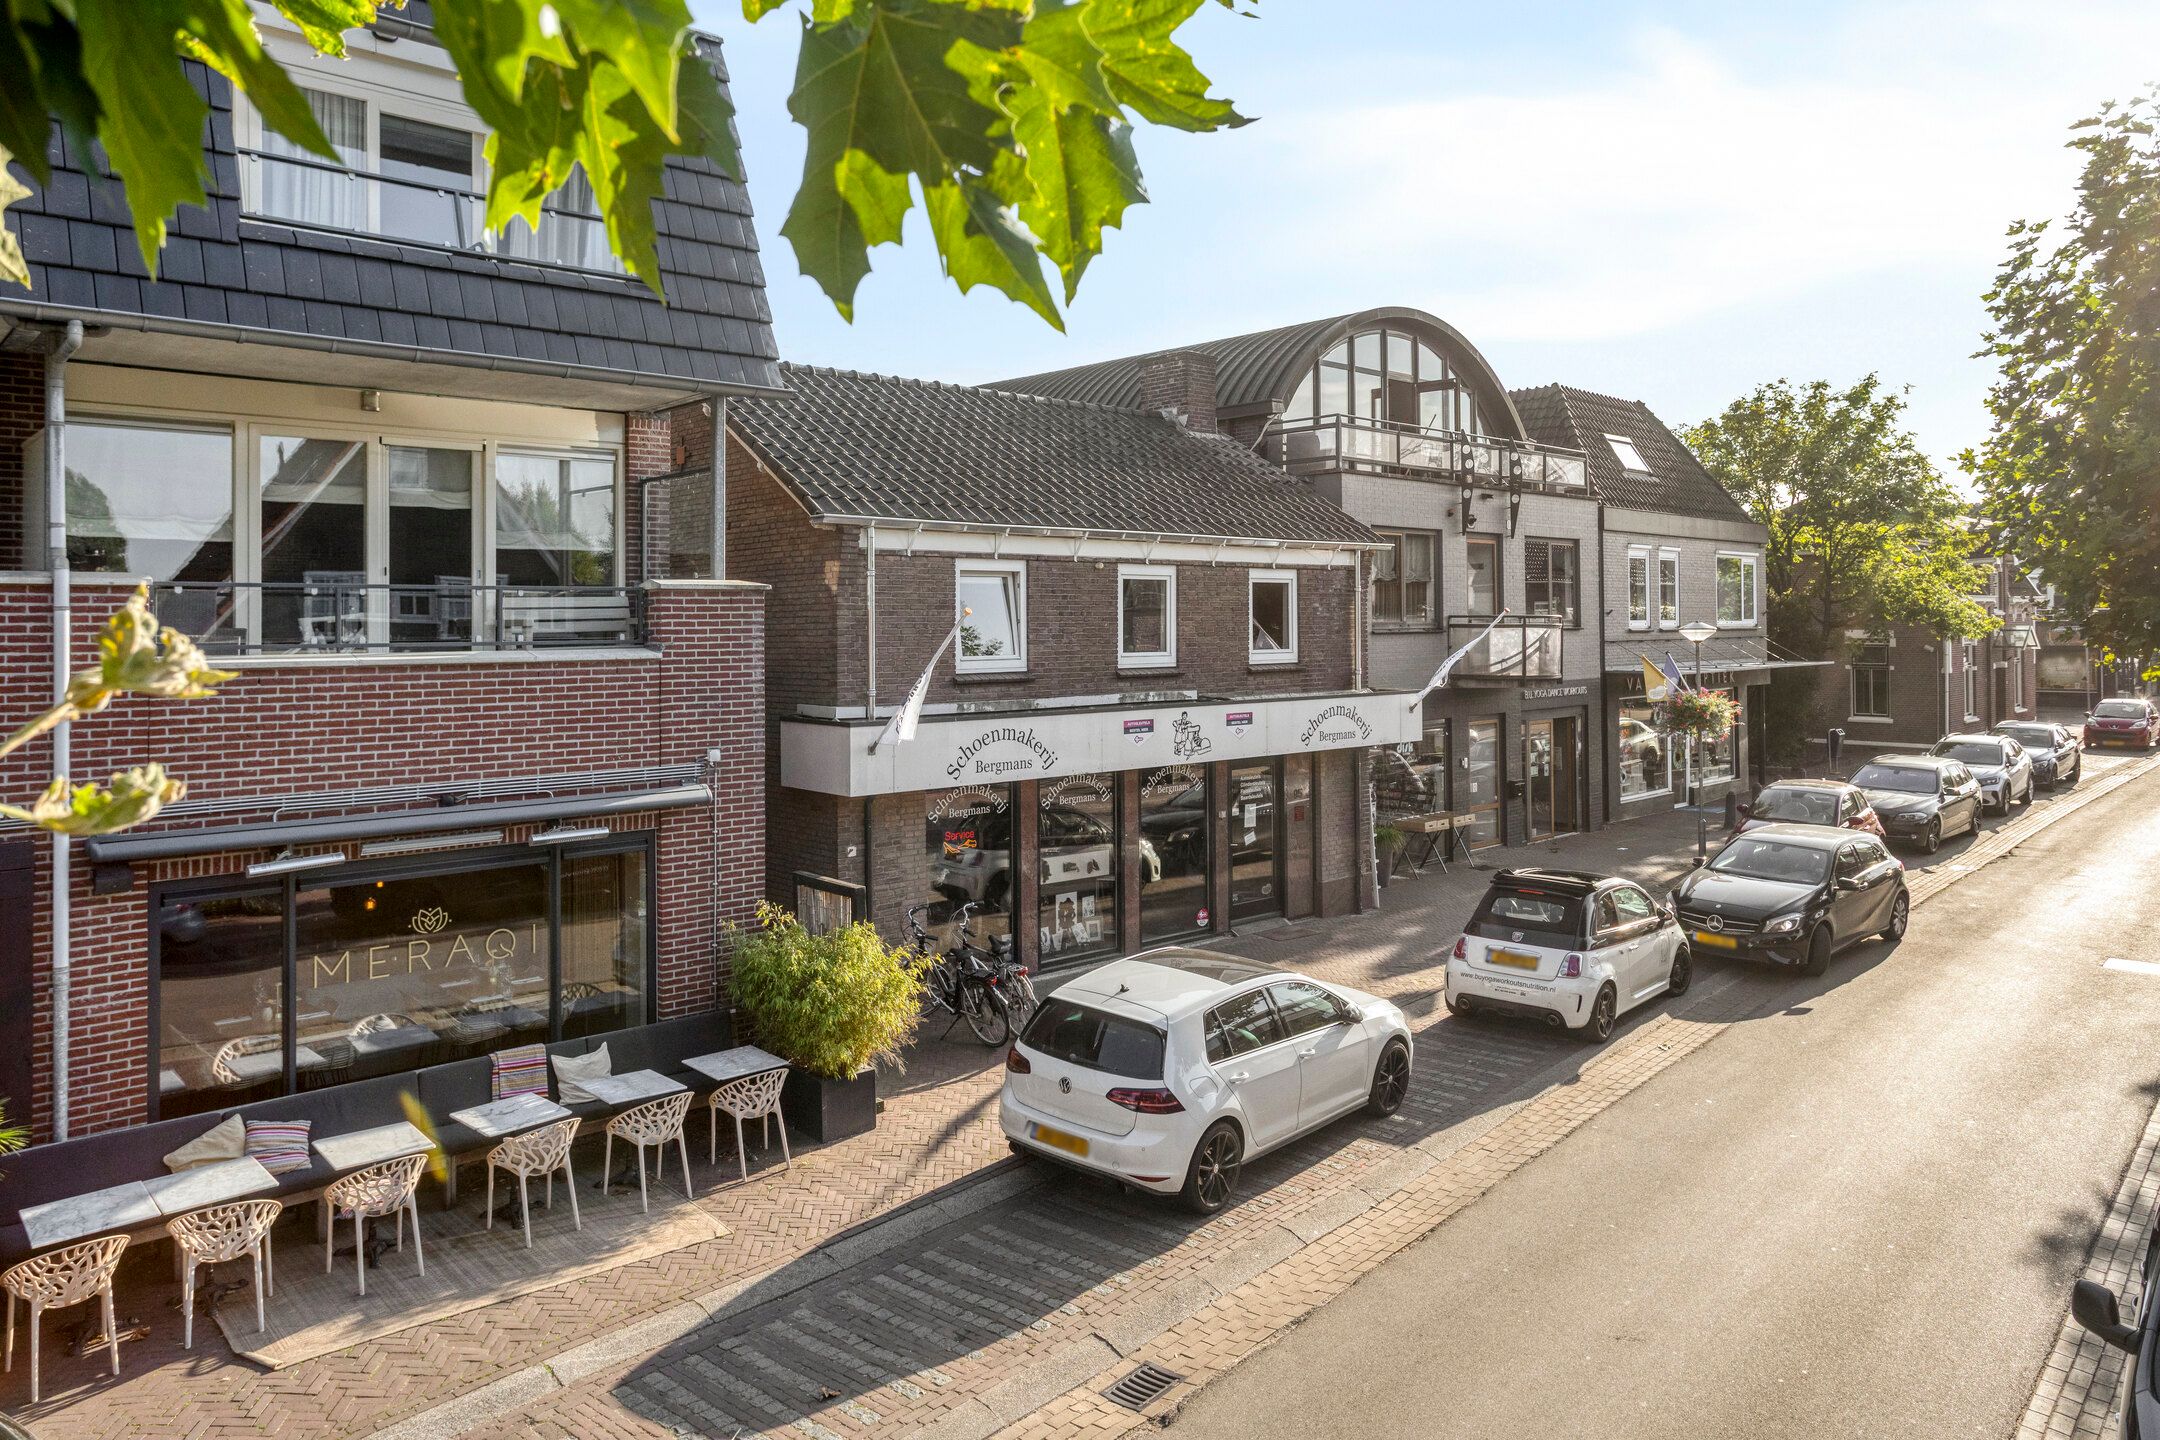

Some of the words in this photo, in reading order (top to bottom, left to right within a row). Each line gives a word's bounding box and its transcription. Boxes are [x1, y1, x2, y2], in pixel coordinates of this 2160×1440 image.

[1300, 705, 1373, 746] Schoenmakerij
[1319, 731, 1356, 743] Bergmans
[946, 727, 1059, 780] Schoenmakerij
[975, 759, 1033, 775] Bergmans
[1040, 773, 1113, 810] Schoenmakerij
[1141, 764, 1205, 798] Schoenmakerij
[1157, 783, 1190, 795] Bergmans
[927, 783, 1009, 824] Schoenmakerij
[1058, 793, 1096, 806] Bergmans
[948, 805, 991, 819] Bergmans
[945, 830, 975, 841] Service
[313, 923, 537, 989] MERAQI
[1460, 971, 1557, 993] www.buyogaworkoutsnutrition.nl
